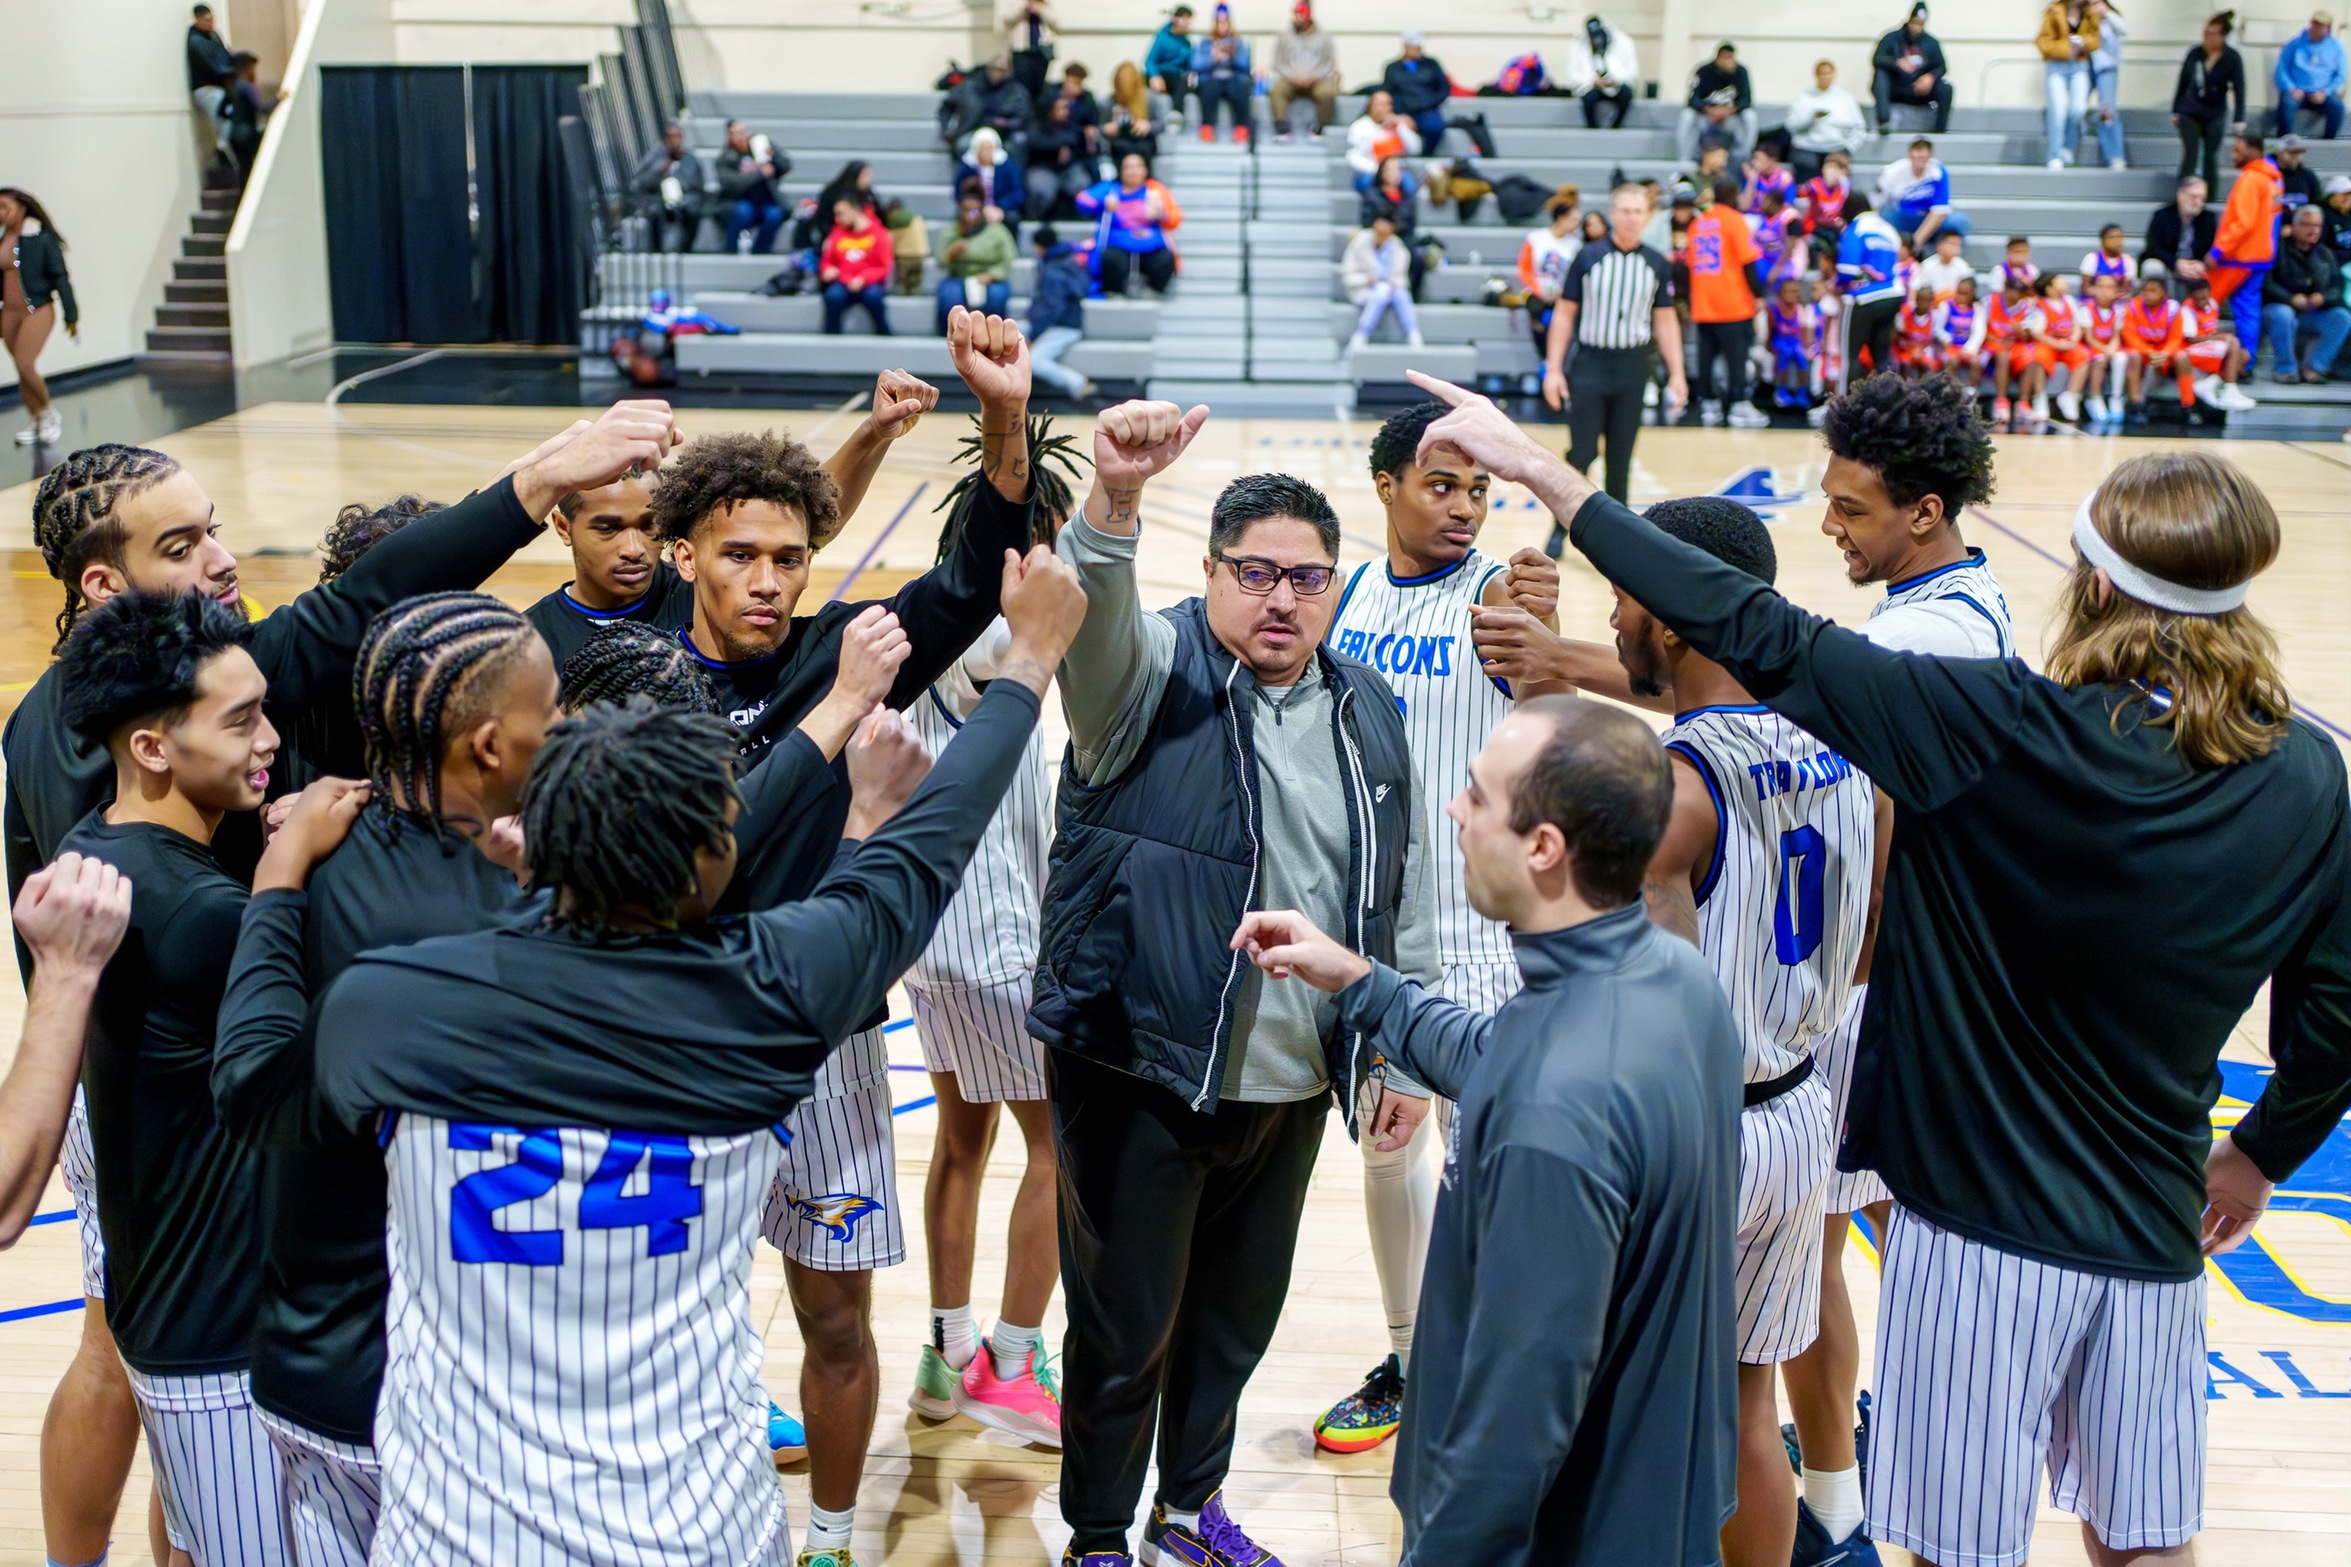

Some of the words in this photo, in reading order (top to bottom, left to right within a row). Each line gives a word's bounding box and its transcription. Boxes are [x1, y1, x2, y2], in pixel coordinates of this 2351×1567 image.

[1337, 628, 1455, 679] FALCONS
[1774, 824, 1827, 967] 0
[449, 1122, 702, 1266] 24
